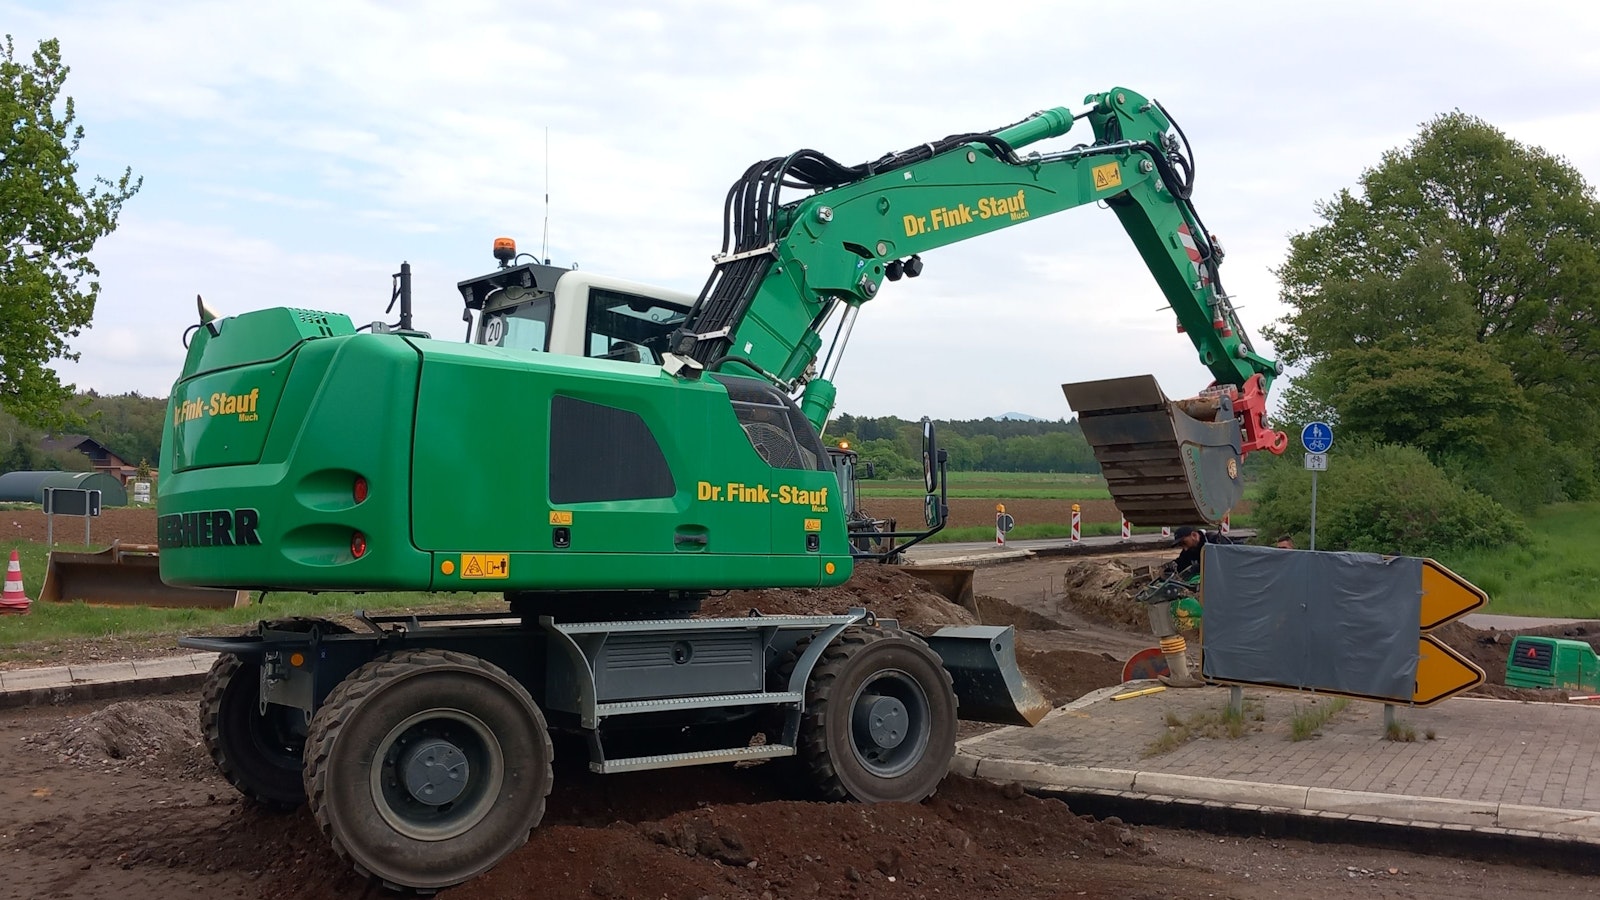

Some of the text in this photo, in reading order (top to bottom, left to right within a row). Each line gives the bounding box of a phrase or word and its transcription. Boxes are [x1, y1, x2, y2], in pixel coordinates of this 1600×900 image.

[930, 190, 1025, 229] Fink-Stauf
[1010, 210, 1030, 221] Much
[488, 321, 501, 342] 20
[181, 388, 259, 423] Fink-Stauf
[239, 413, 259, 422] Much
[698, 481, 828, 506] Dr. Fink-Stauf
[811, 504, 829, 513] Much
